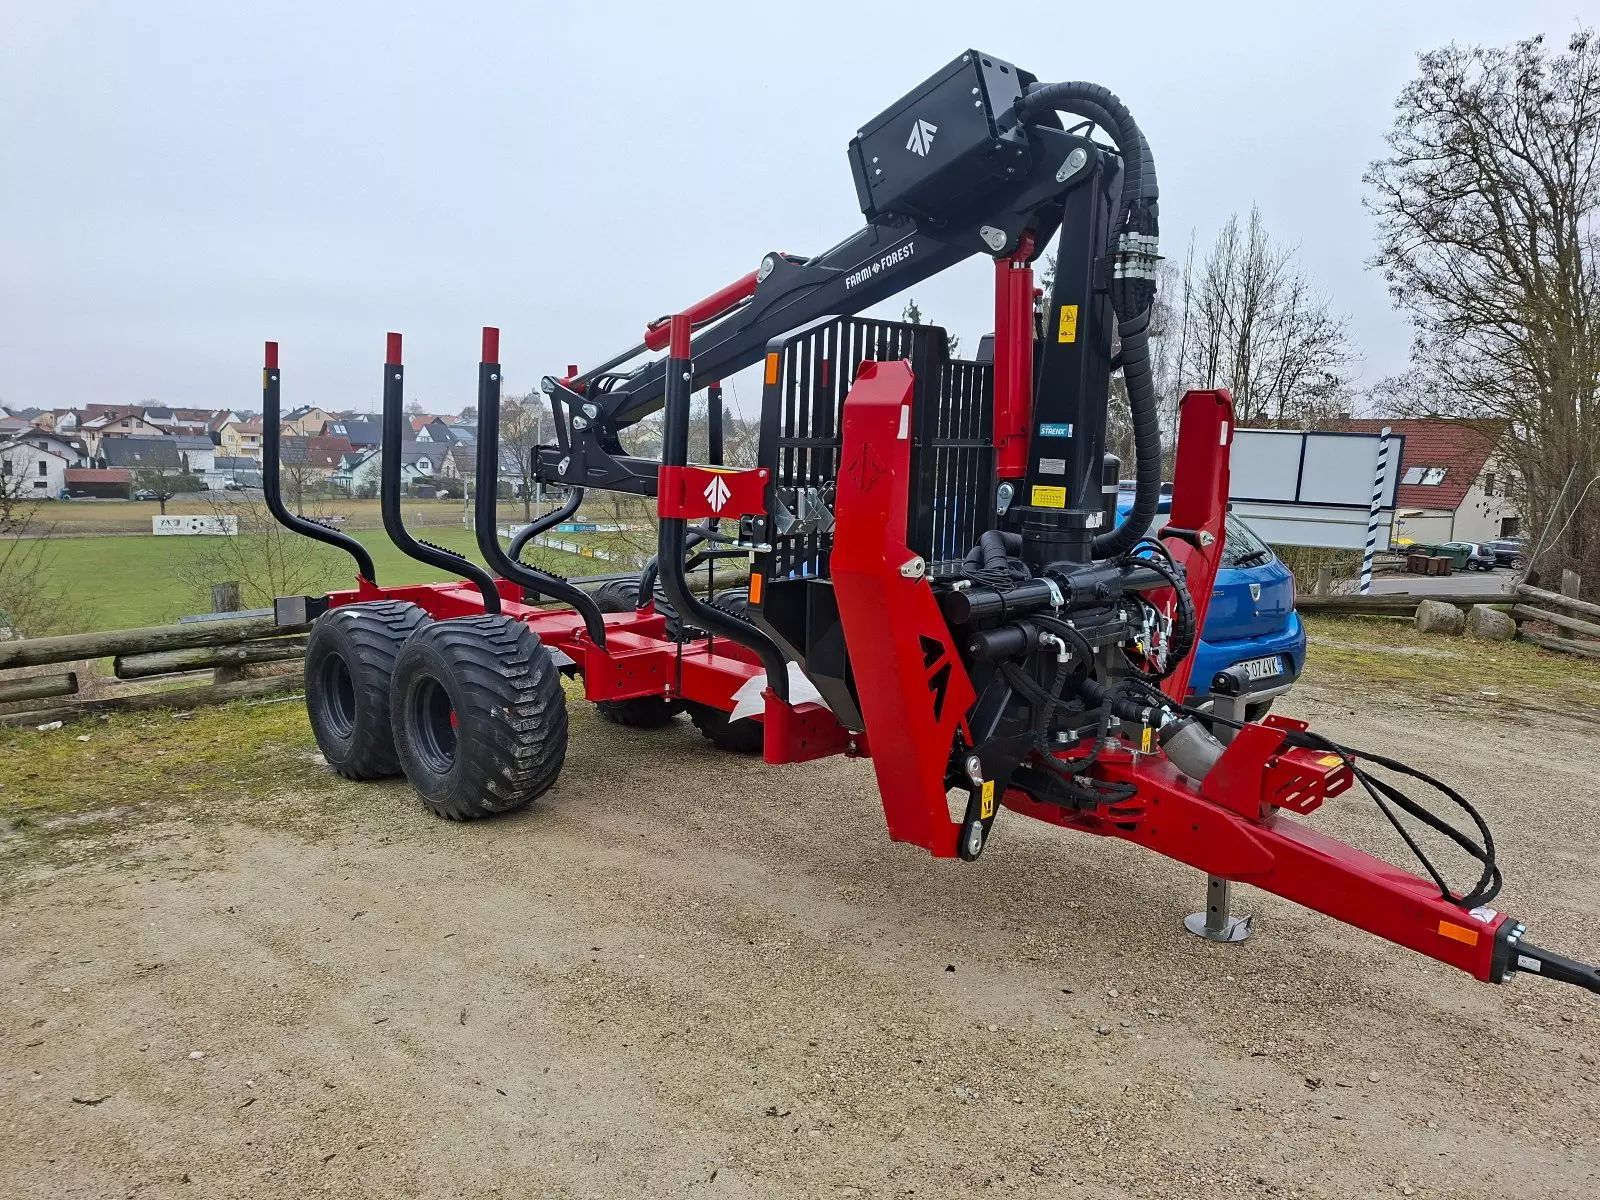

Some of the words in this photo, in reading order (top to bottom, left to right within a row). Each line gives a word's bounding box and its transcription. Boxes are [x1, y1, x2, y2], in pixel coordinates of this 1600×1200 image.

[845, 266, 872, 290] FARMI
[880, 242, 914, 271] FOREST
[1040, 427, 1067, 435] STRENX
